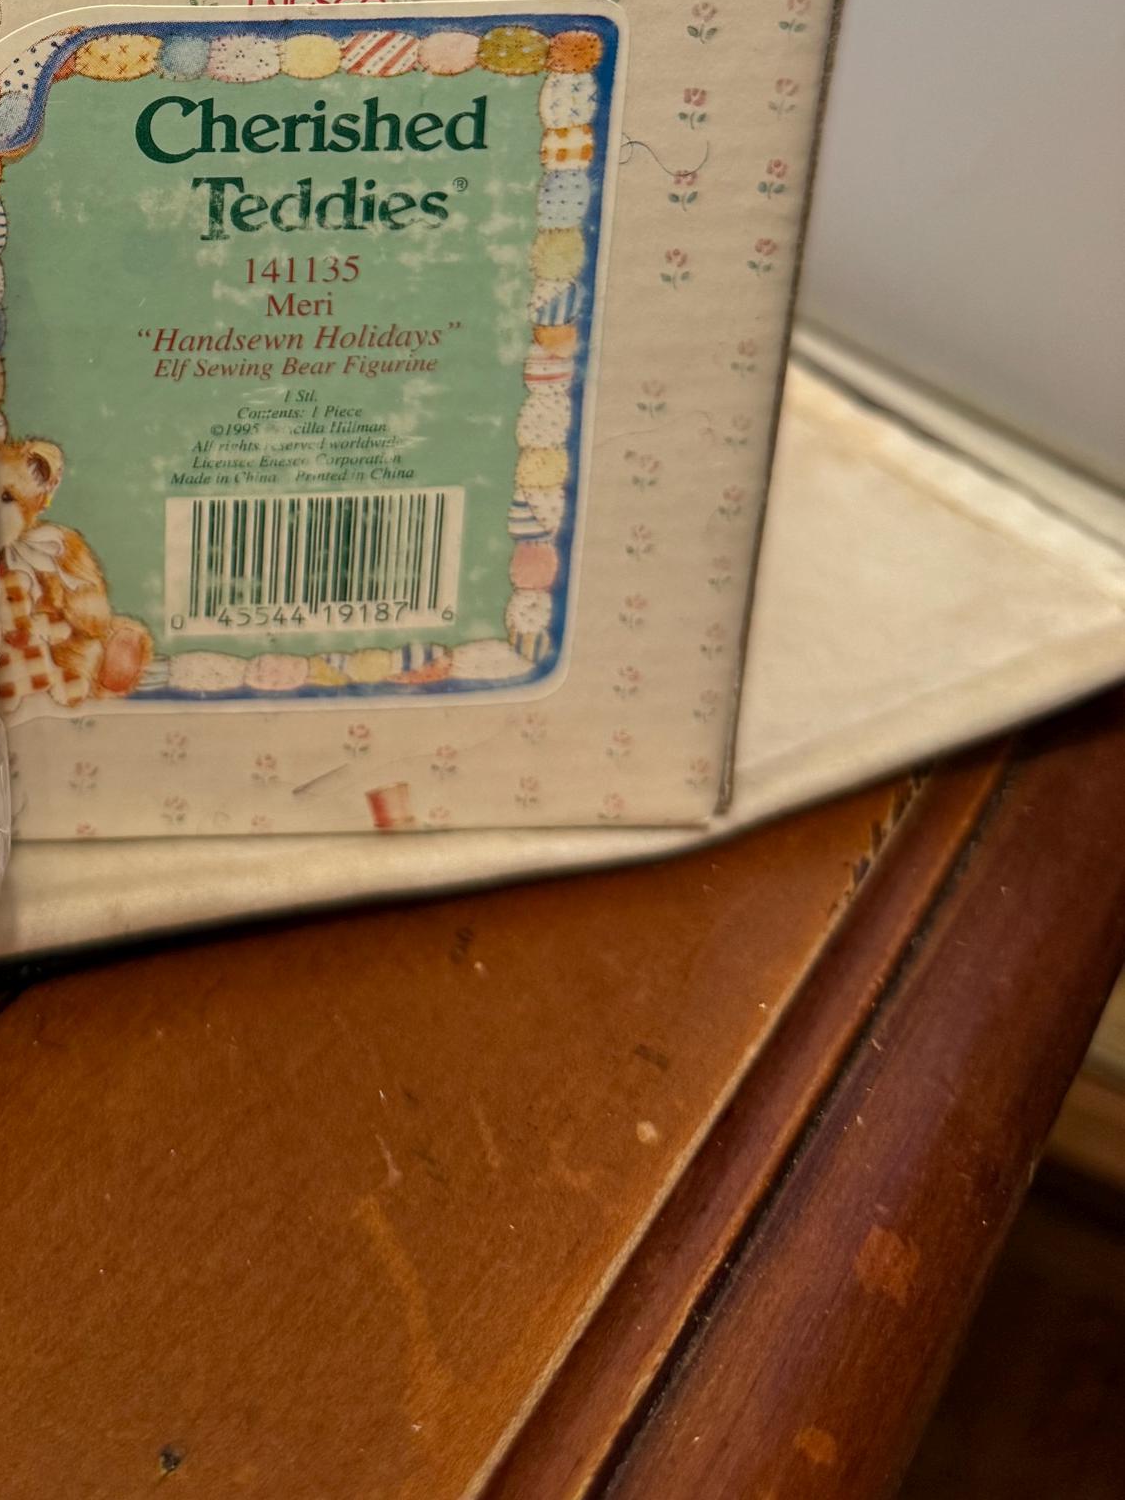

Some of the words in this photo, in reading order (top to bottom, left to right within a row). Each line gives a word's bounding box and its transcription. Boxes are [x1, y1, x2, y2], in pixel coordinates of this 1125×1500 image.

[135, 95, 488, 164] Cherished
[245, 255, 359, 284] 141135
[266, 292, 333, 316] Meri
[154, 358, 191, 381] Elf
[193, 357, 273, 380] Sewing
[282, 355, 336, 375] Bear
[342, 354, 438, 378] Figurine
[237, 407, 305, 419] Contents:
[325, 405, 363, 418] Piece
[192, 440, 213, 452] All
[171, 471, 211, 485] Made
[216, 471, 231, 485] in
[370, 465, 415, 480] China
[216, 604, 306, 628] 45544
[324, 599, 409, 624] 19187
[441, 603, 454, 622] 6
